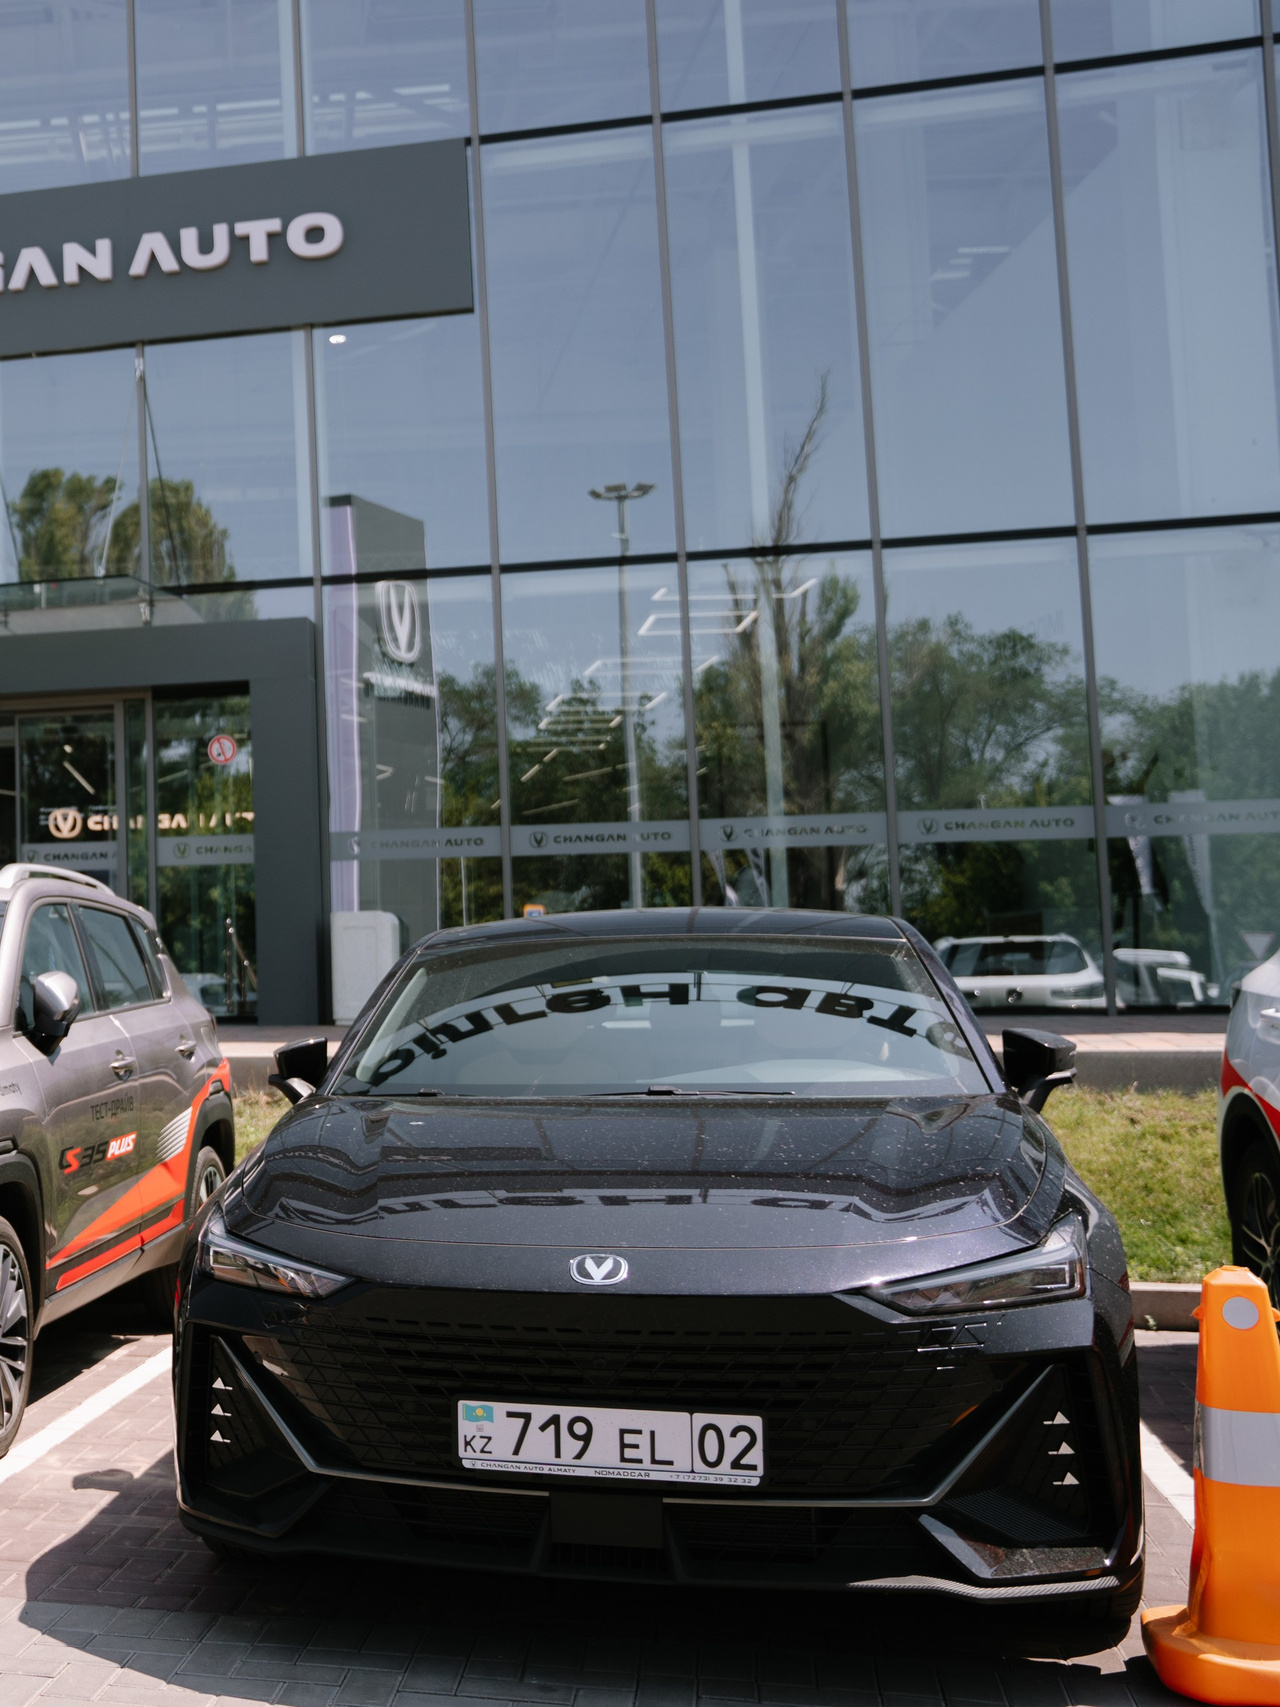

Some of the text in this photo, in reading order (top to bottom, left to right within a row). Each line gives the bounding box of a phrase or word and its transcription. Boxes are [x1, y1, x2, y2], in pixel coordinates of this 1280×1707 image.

[128, 211, 344, 278] AUTO
[944, 818, 1076, 831] CHANGAN AUTO
[444, 837, 484, 847] AUTO
[553, 833, 627, 844] CHANGAN
[43, 852, 109, 863] CHANGAN
[90, 1093, 134, 1121] ТЕСТ-ДРАЙВ
[58, 1133, 137, 1174] CS35 PLUS
[463, 1411, 758, 1471] KZ 719 EL 02
[480, 1462, 521, 1470] CHANGAN
[594, 1469, 651, 1478] NOMADCAR
